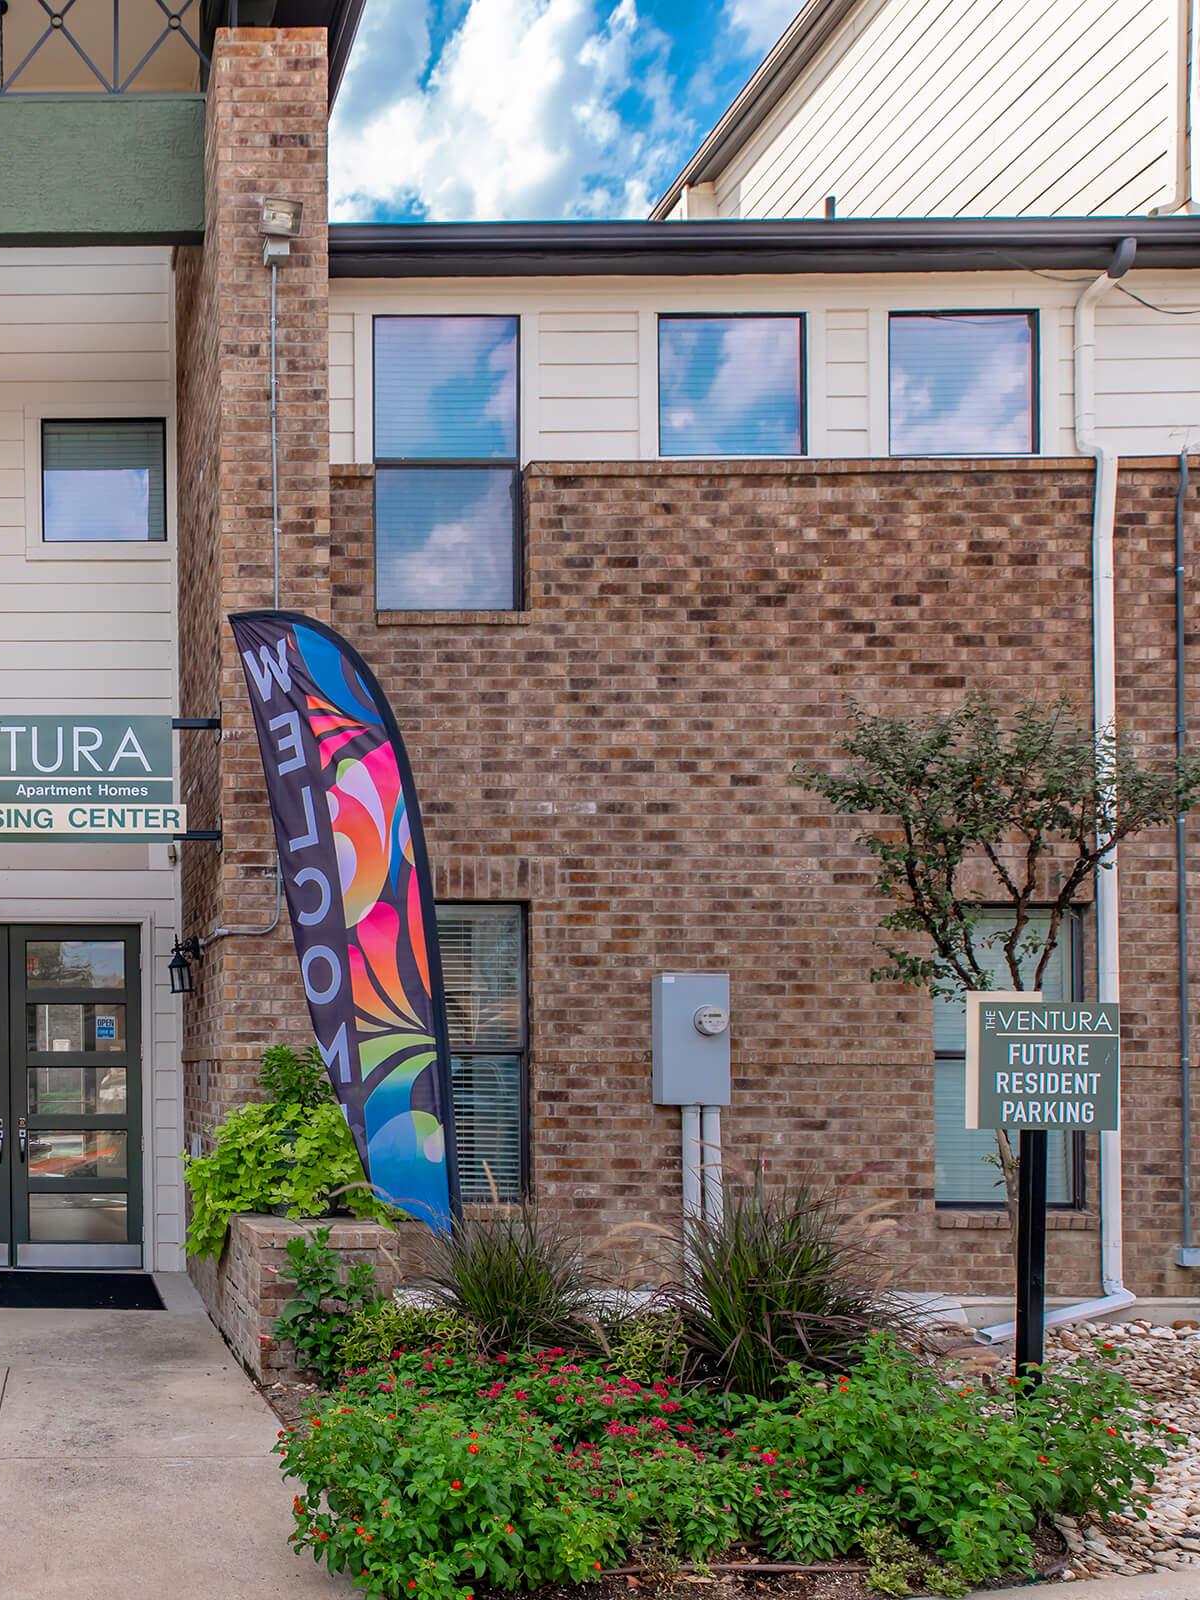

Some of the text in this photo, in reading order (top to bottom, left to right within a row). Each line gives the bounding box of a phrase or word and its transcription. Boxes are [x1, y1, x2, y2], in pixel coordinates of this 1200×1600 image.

[16, 783, 149, 798] Apartment Homes
[68, 807, 181, 829] CENTER
[984, 1010, 1113, 1032] THE VENTURA
[1008, 1043, 1089, 1066] FUTURE
[995, 1071, 1102, 1095] RESIDENT
[1001, 1100, 1095, 1124] PARKING
